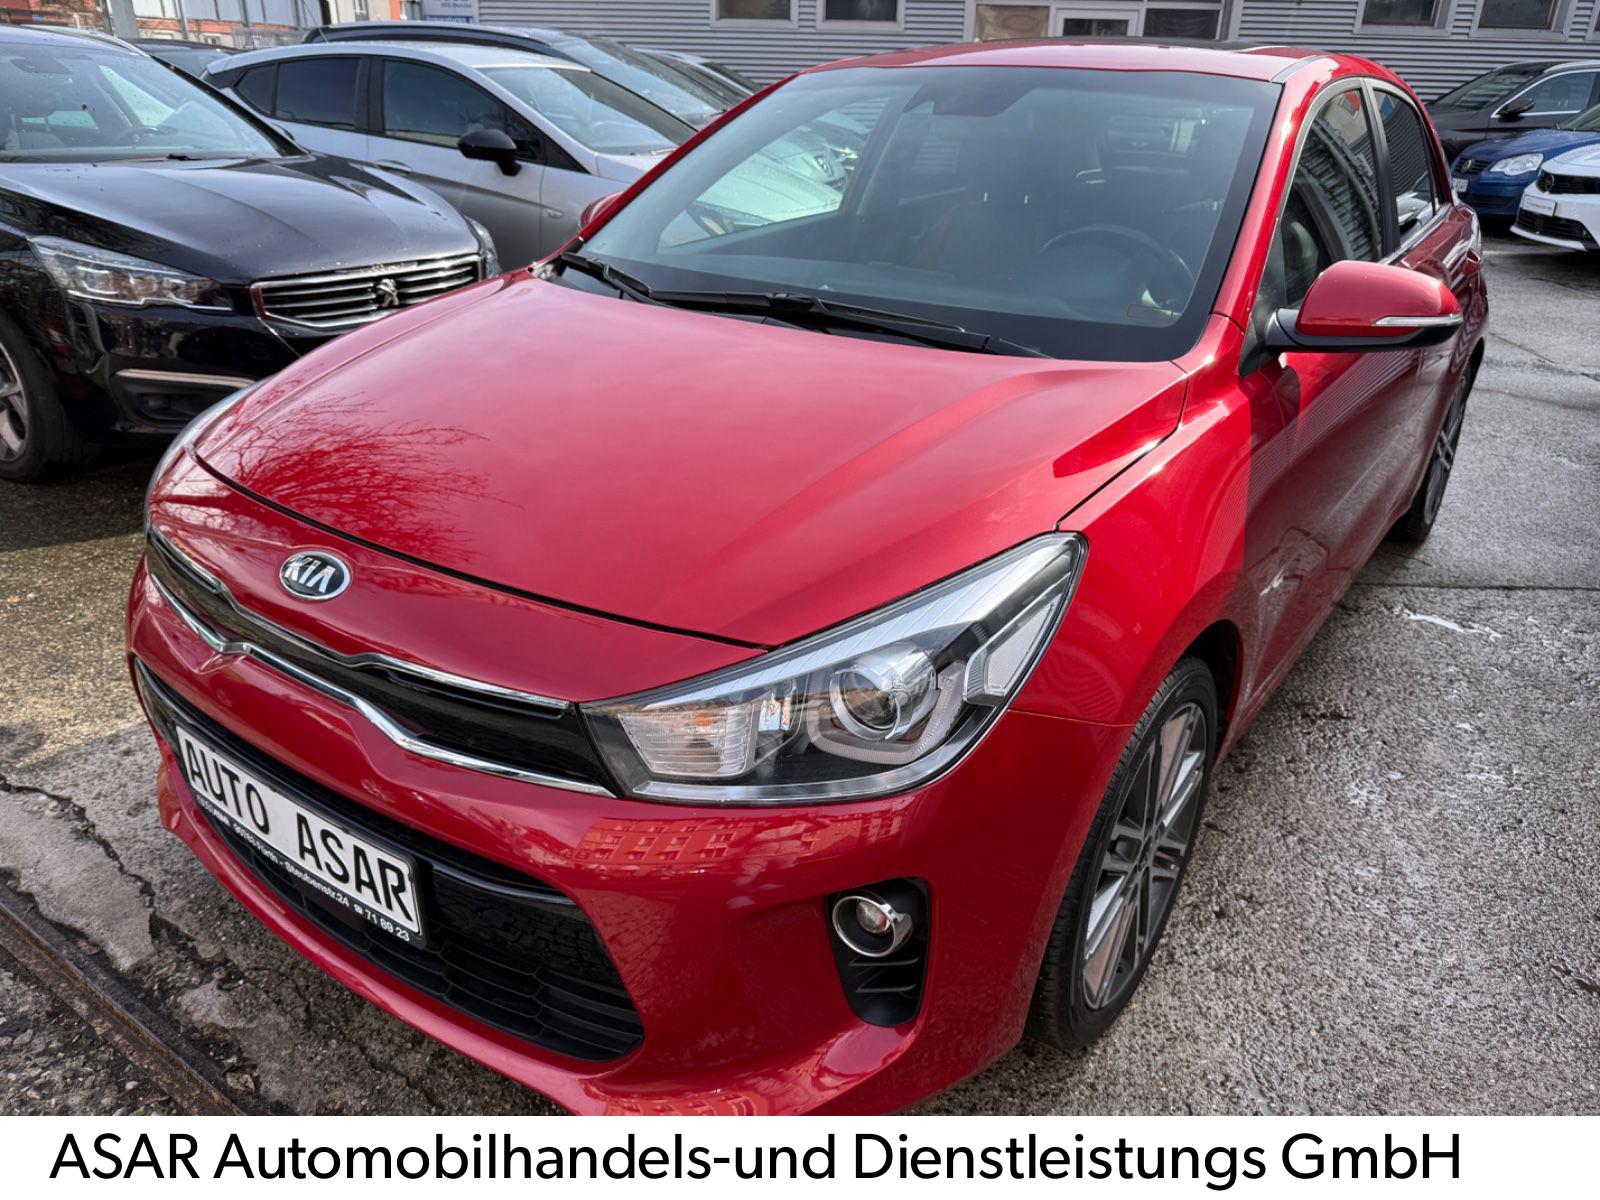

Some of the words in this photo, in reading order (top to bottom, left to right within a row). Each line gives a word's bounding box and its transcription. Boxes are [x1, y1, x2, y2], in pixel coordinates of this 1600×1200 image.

[284, 554, 336, 593] KIA
[184, 738, 270, 836] AUTO
[296, 811, 413, 922] ASAR
[365, 909, 378, 924] 71
[396, 927, 410, 942] 23
